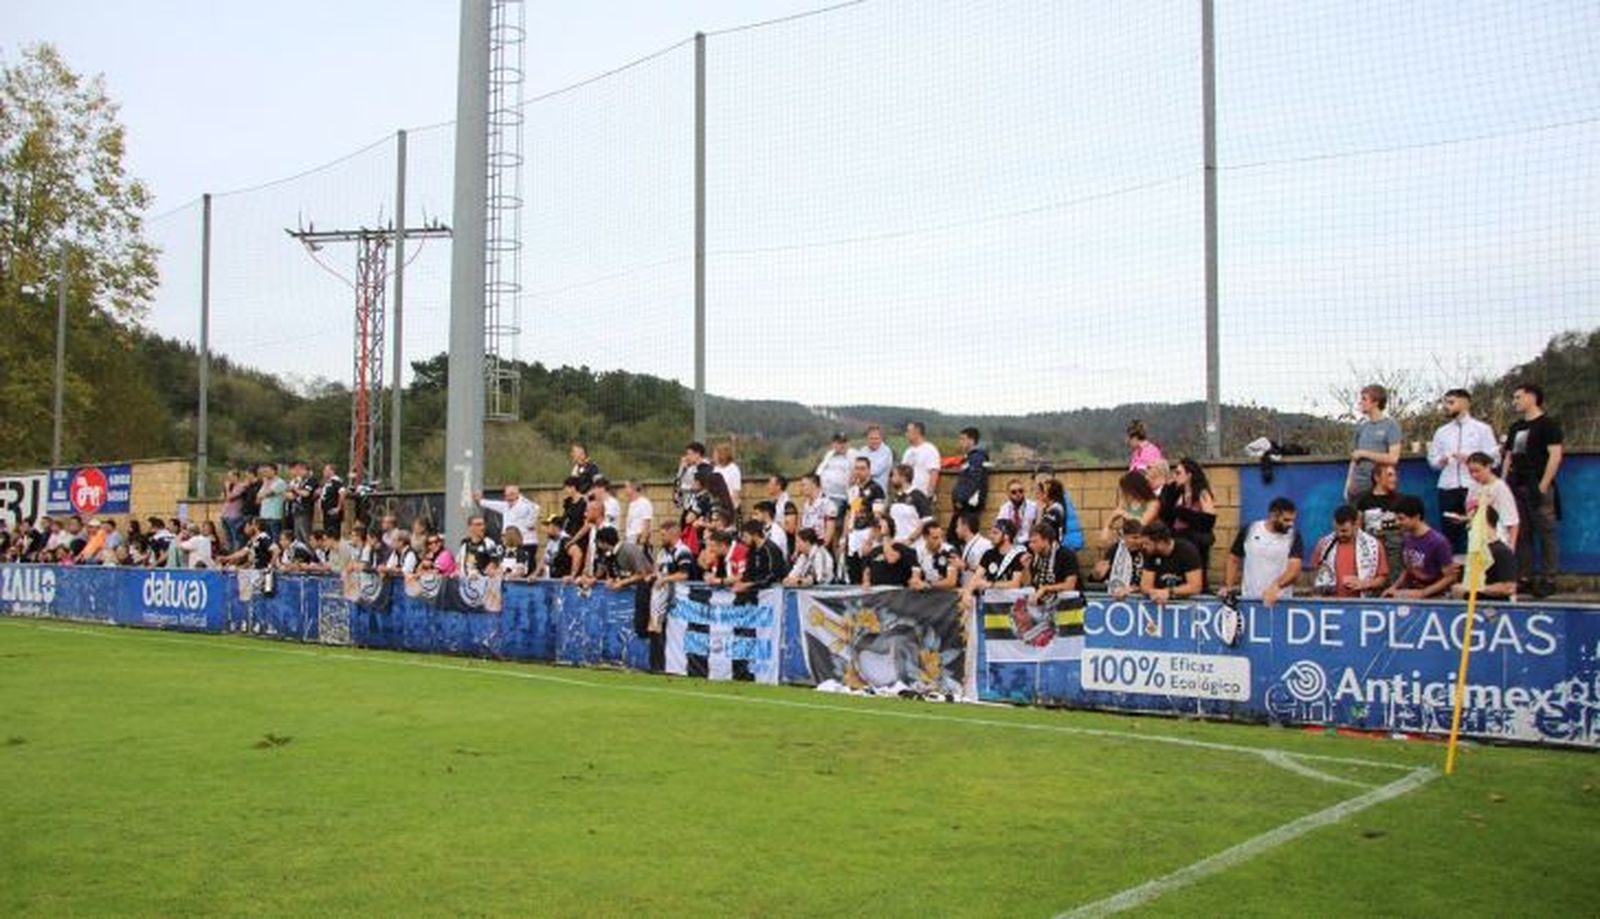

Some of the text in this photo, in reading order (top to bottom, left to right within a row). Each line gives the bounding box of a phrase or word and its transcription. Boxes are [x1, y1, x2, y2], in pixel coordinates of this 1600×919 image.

[2, 566, 56, 604] ZALLO
[143, 571, 208, 610] datu(a)
[1083, 601, 1557, 655] CONTROL DE PLAGAS
[1089, 655, 1214, 689] 100% Eficaz
[1334, 666, 1555, 714] Anticimex
